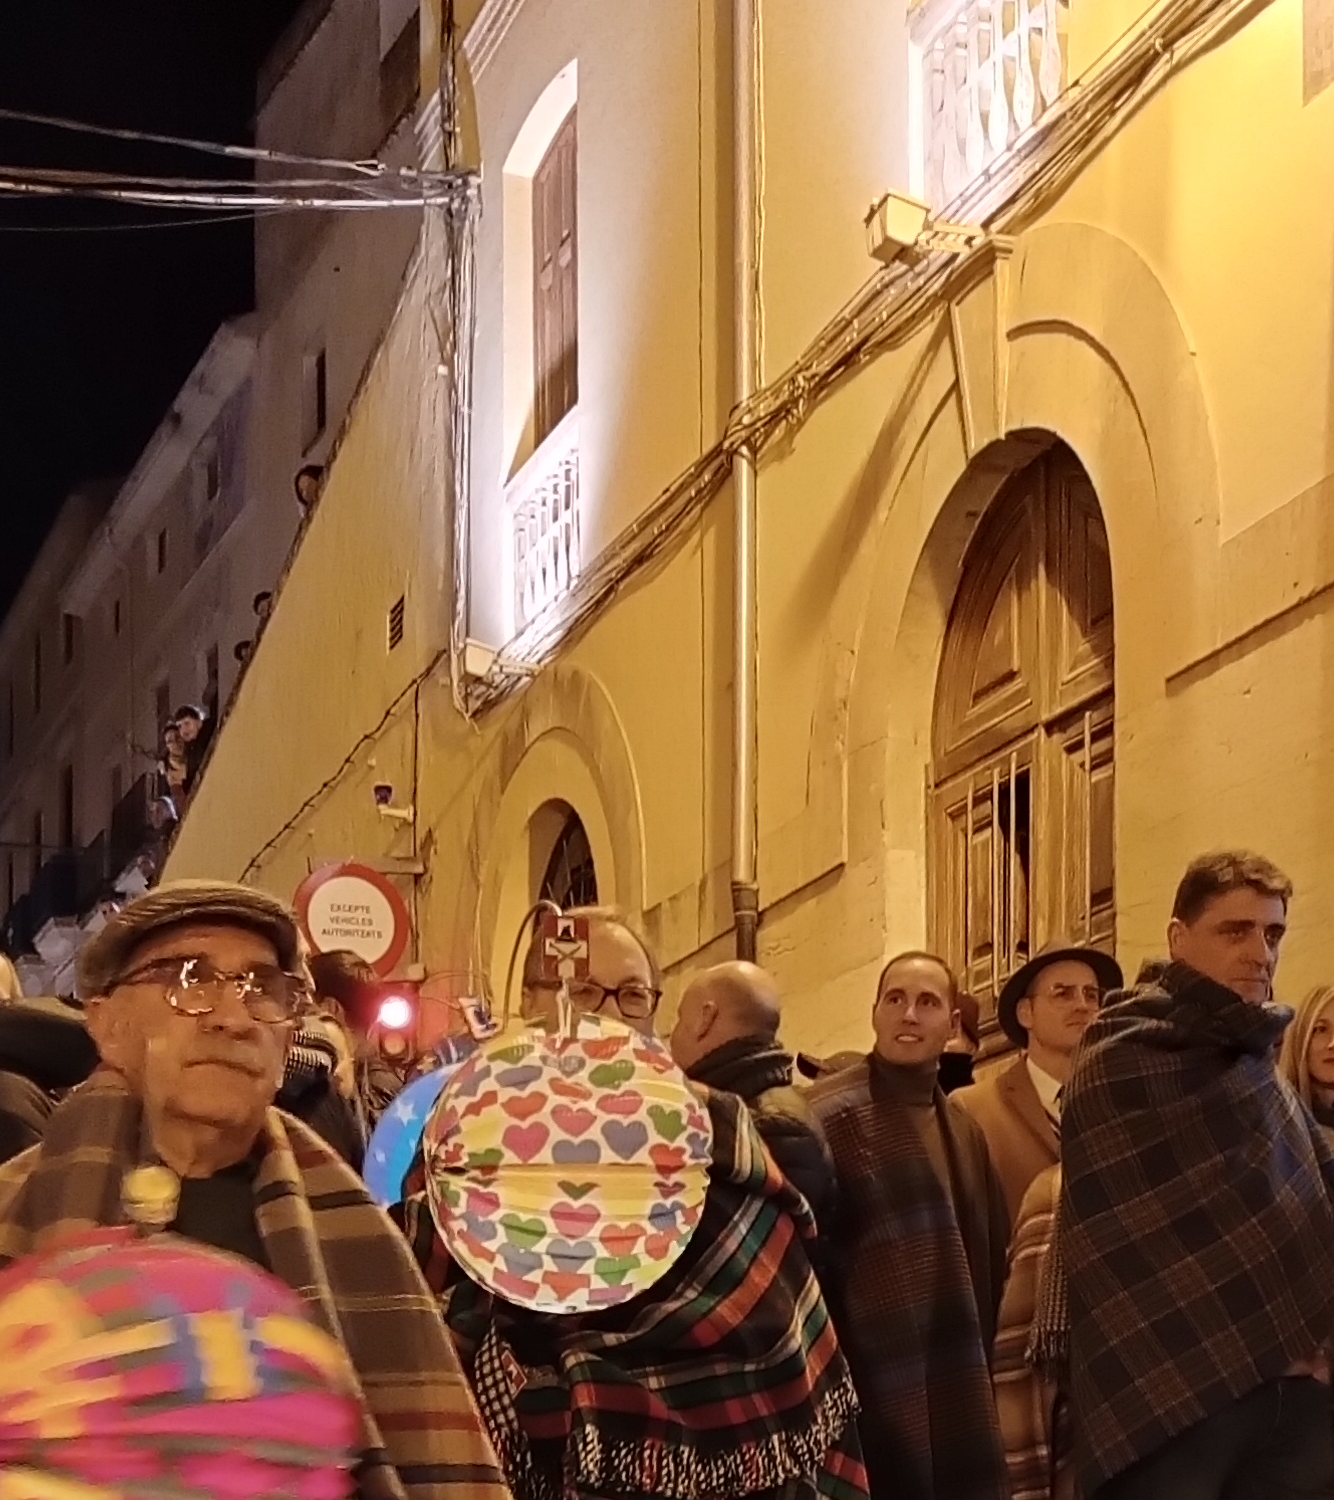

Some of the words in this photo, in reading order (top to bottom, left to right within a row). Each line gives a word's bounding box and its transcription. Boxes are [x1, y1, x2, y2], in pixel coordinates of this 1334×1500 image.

[330, 903, 371, 914] EXCEPTE
[329, 916, 373, 926] VEHICLES
[321, 928, 383, 939] AUTORITZATS
